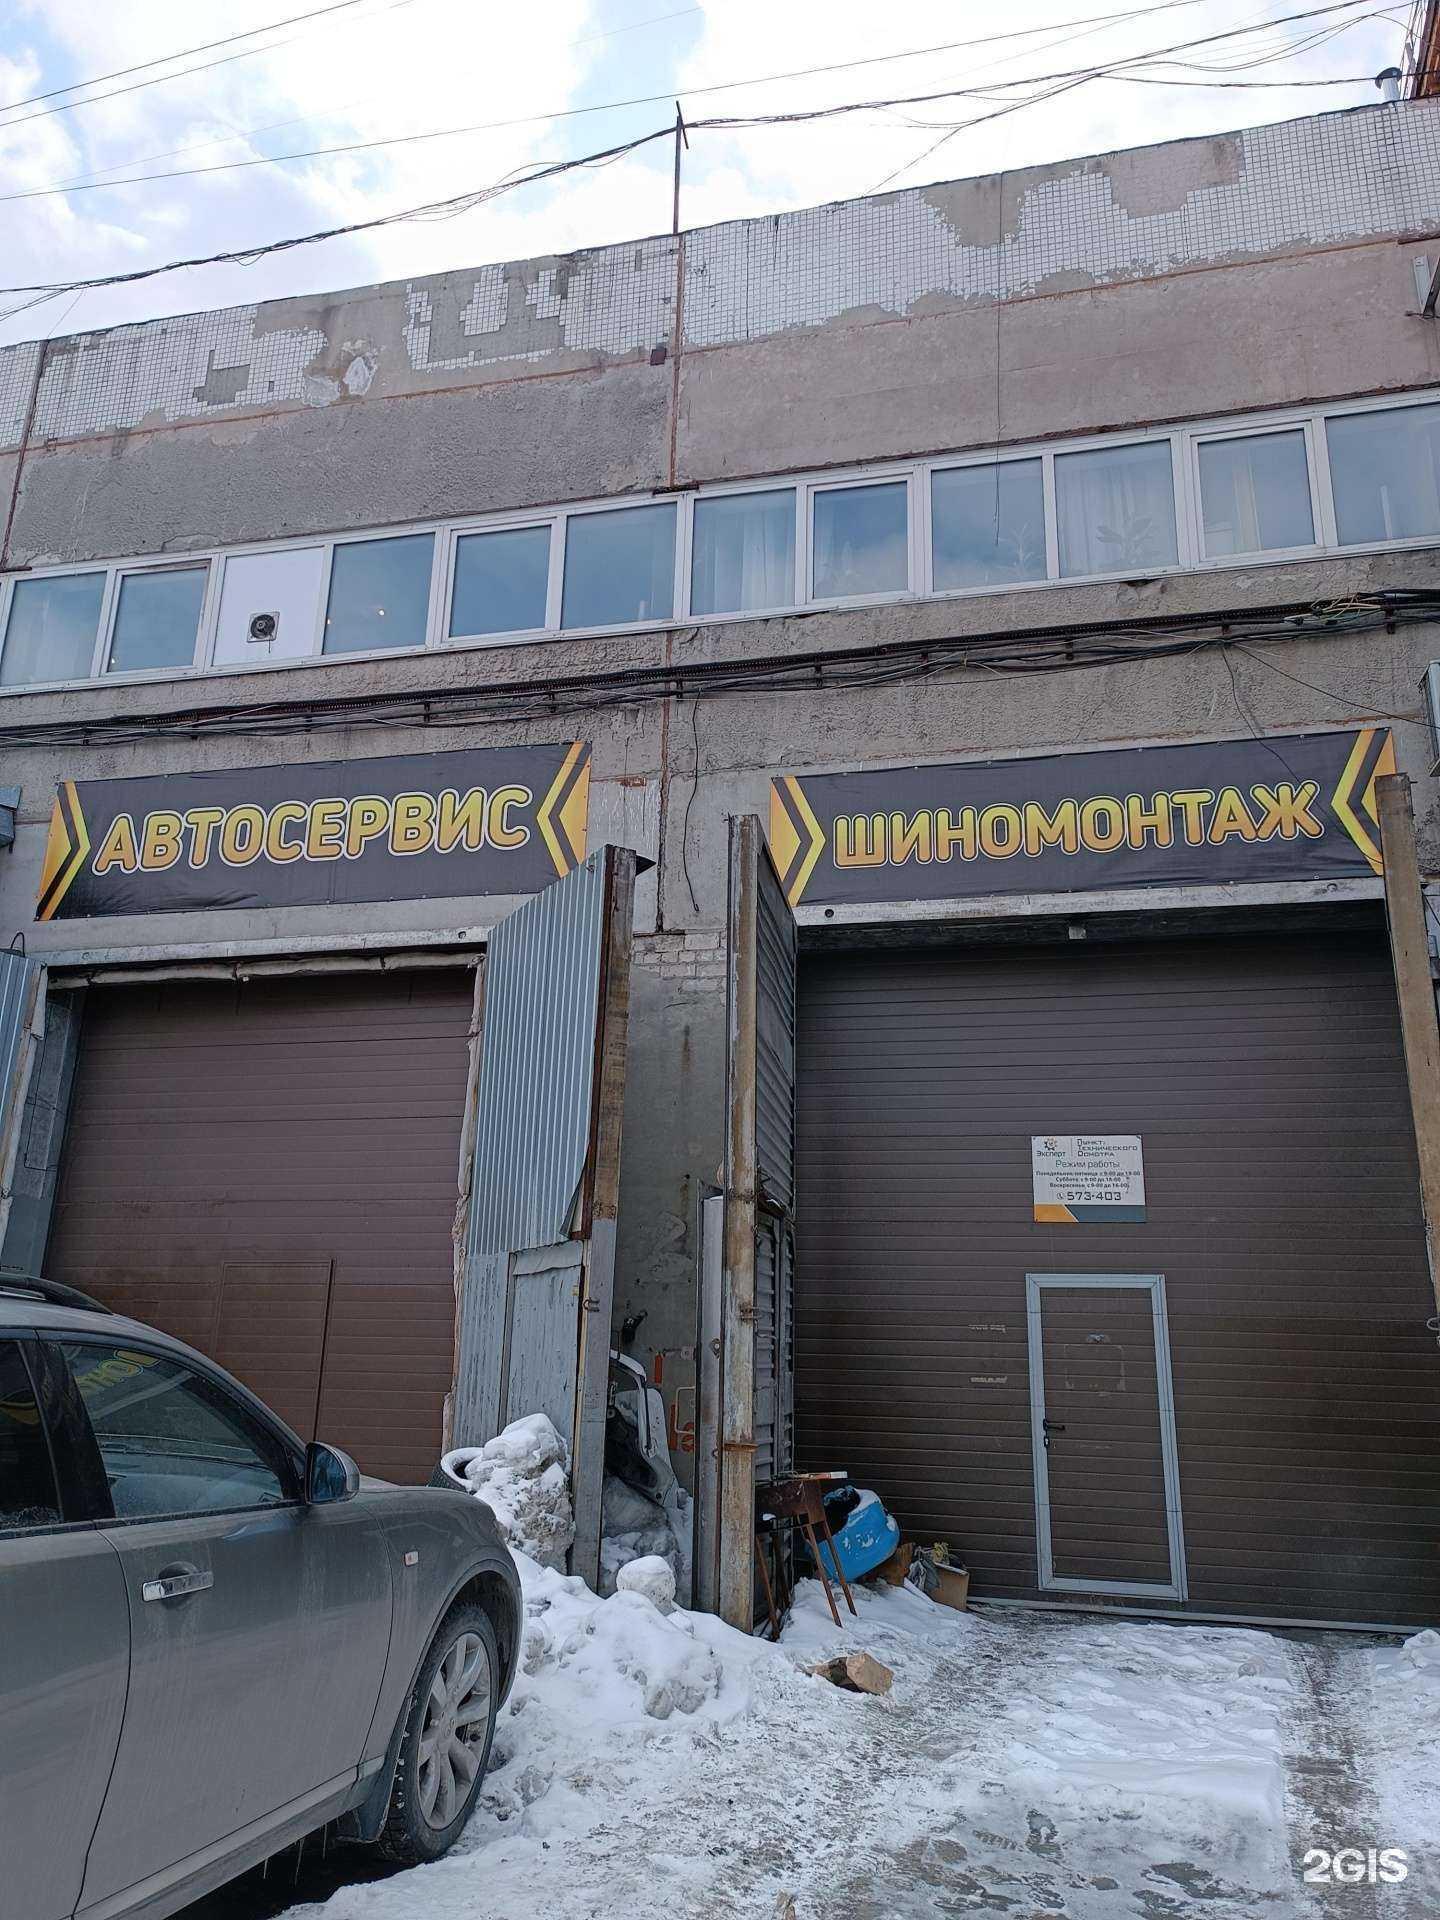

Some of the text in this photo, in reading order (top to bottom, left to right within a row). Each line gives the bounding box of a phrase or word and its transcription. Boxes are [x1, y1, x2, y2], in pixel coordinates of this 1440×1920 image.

[91, 784, 532, 876] АВТОСЕРВИС
[833, 780, 1324, 869] ШИНОМОНТАЖ
[1036, 1150, 1066, 1158] Эксперт
[1055, 1159, 1121, 1169] Режим работы
